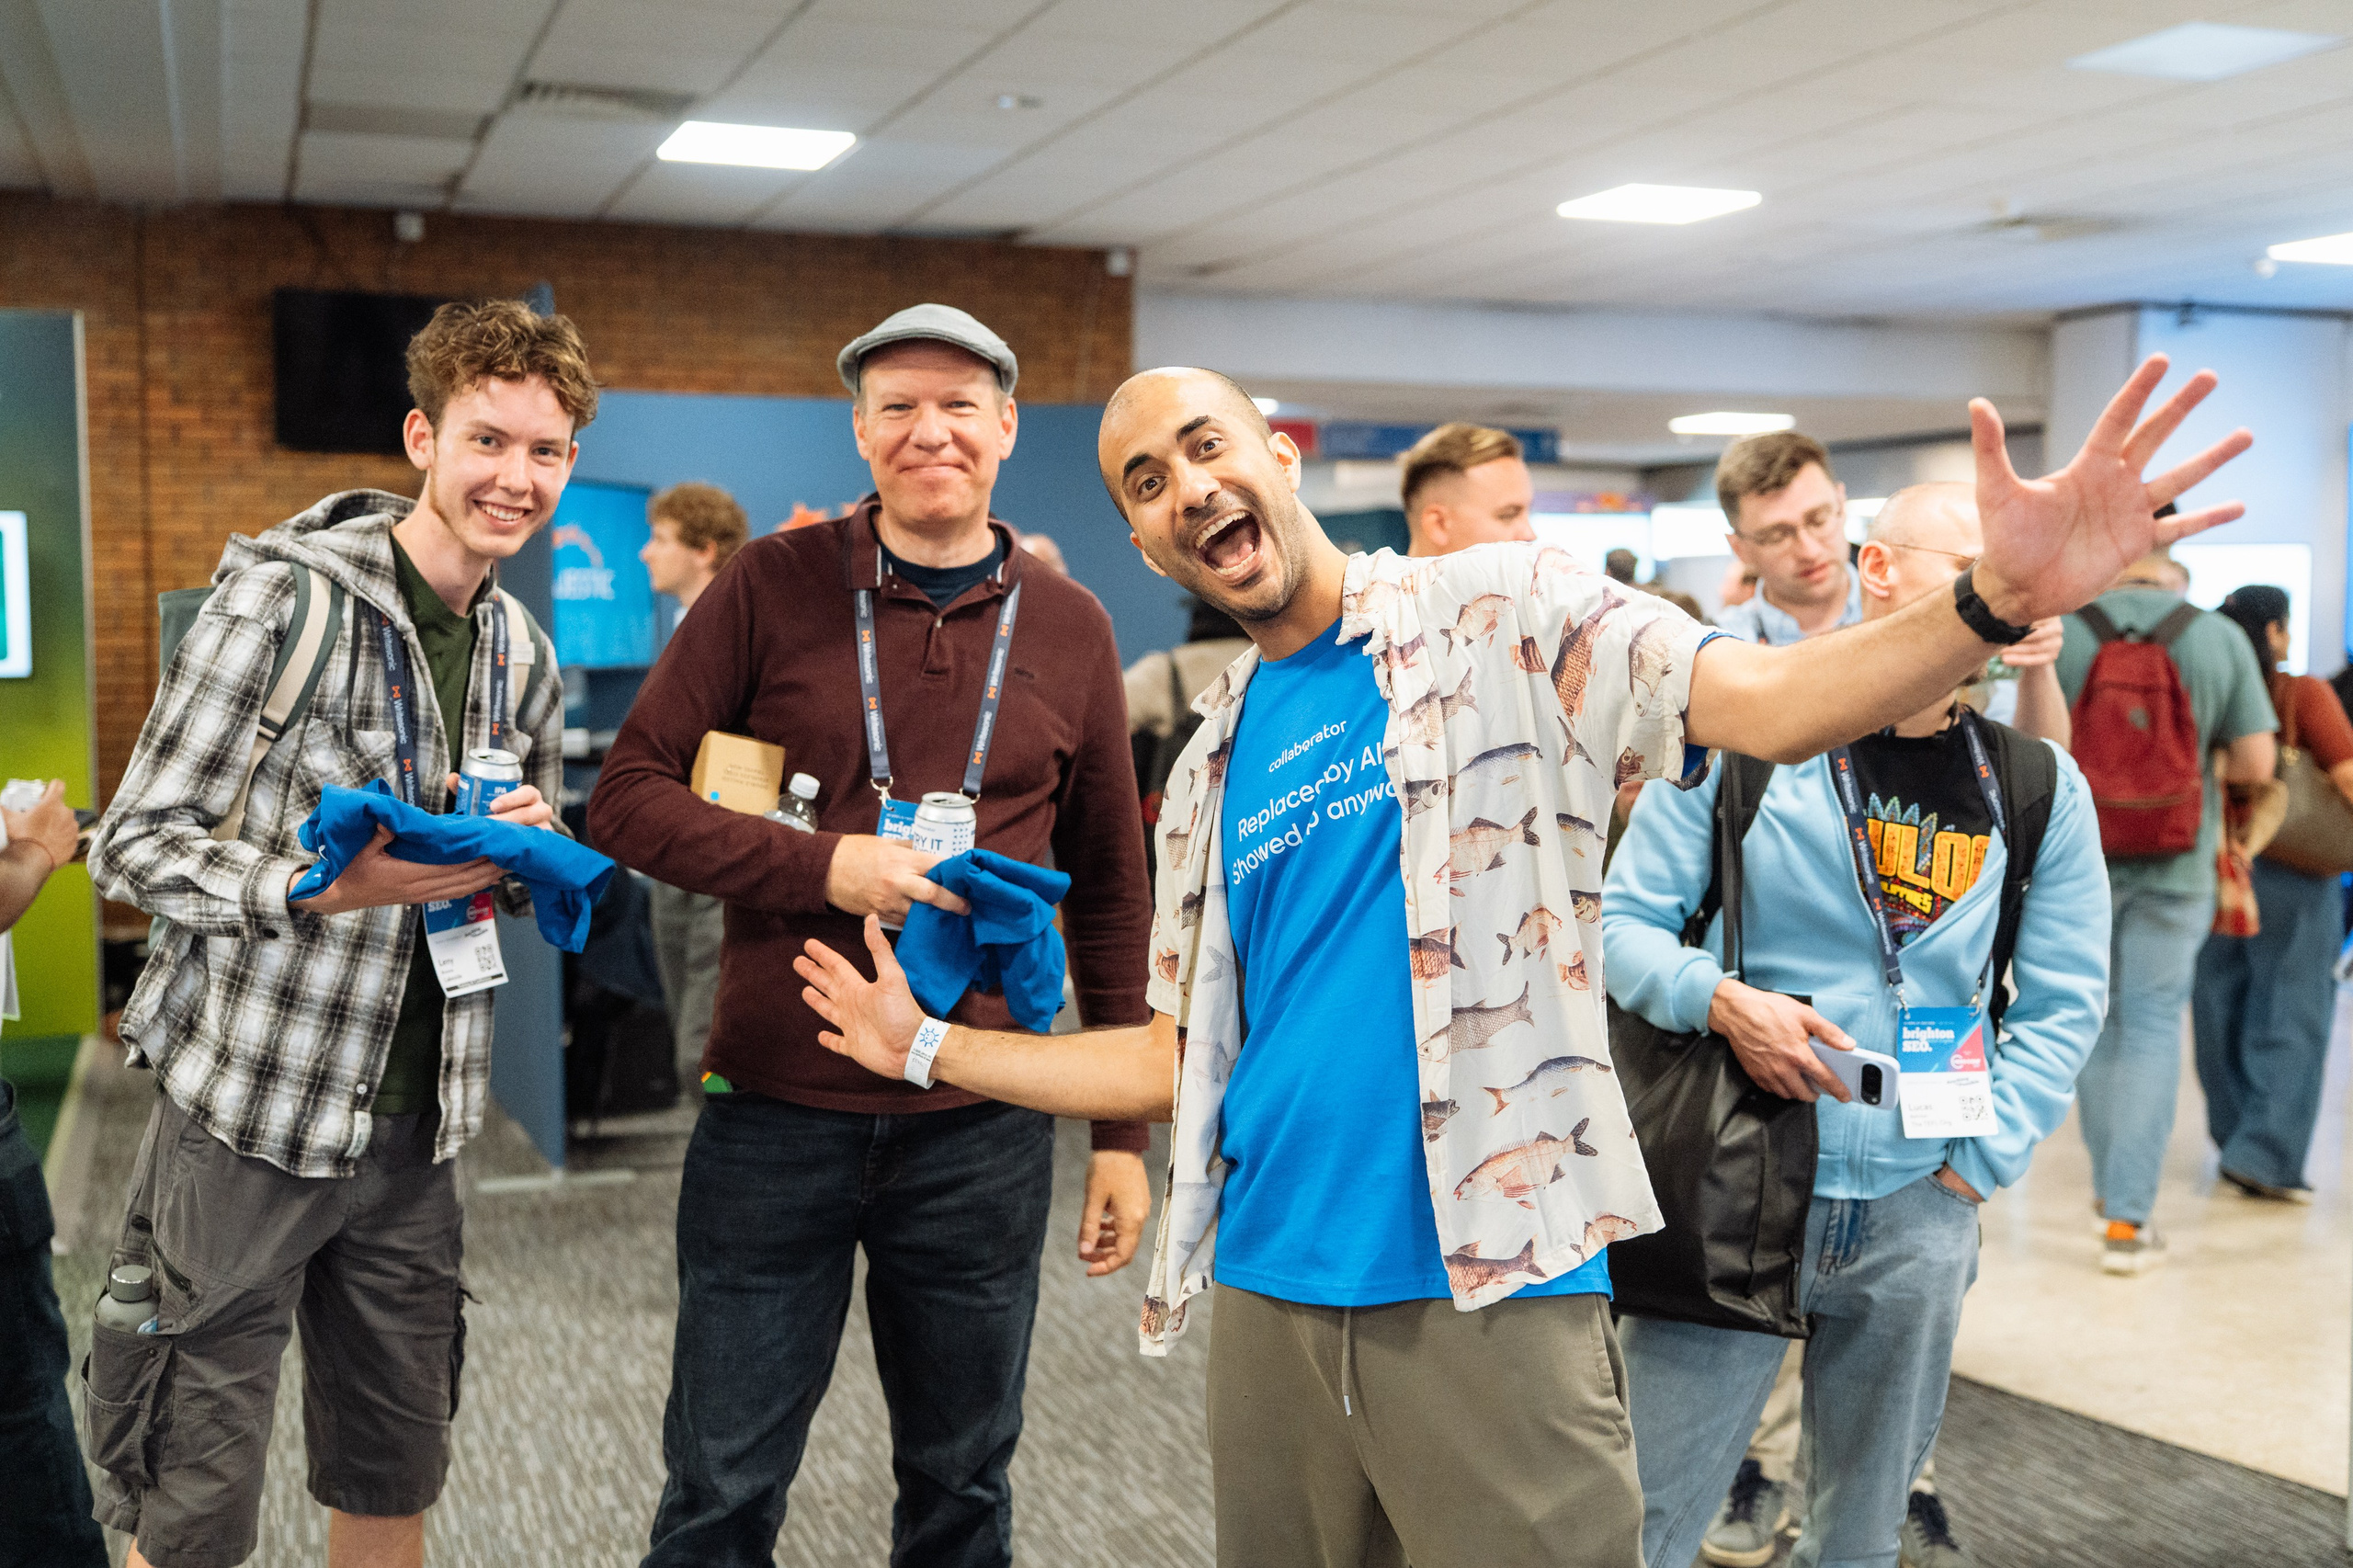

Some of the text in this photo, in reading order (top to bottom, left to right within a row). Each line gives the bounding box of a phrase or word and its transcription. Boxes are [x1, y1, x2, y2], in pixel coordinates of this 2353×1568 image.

[382, 626, 397, 671] Writesonic
[393, 699, 408, 744] Writesonic
[1268, 721, 1347, 772] collaborator
[1324, 757, 1354, 784] by
[1360, 742, 1382, 771] AI
[930, 838, 943, 851] IT
[1233, 824, 1303, 885] Showed
[1902, 1040, 1933, 1052] SEO.
[1903, 1026, 1955, 1042] brighton
